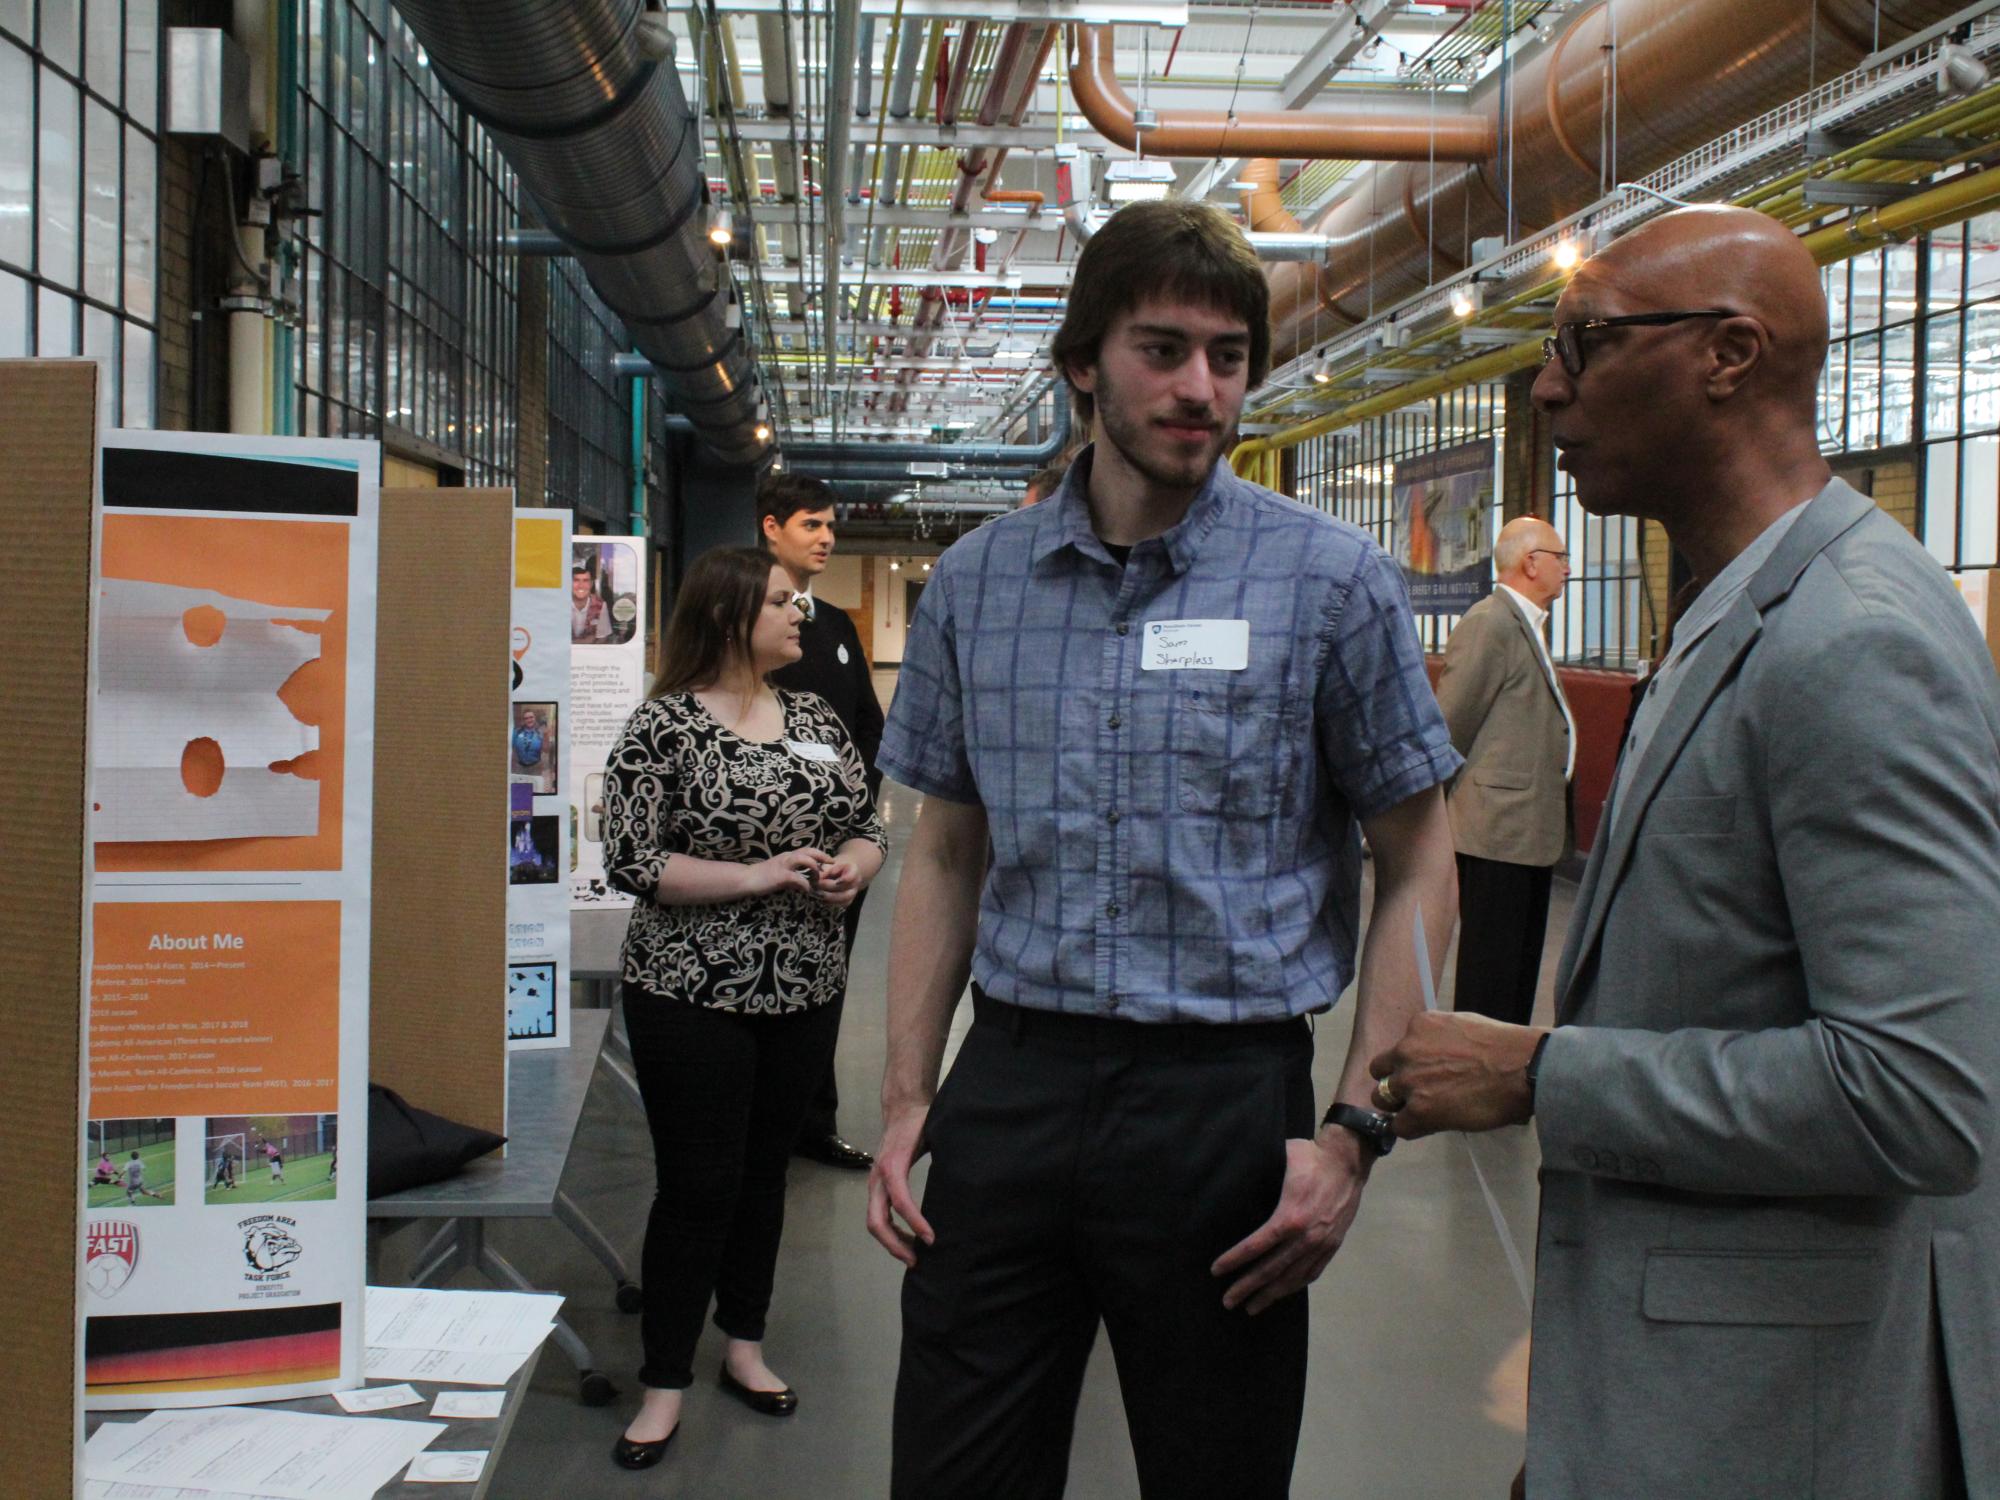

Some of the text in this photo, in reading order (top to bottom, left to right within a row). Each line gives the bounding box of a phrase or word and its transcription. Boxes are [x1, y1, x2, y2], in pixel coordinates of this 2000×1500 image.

[1158, 636, 1189, 649] Sam
[1156, 651, 1214, 667] Sharpless
[148, 932, 245, 951] About Me
[237, 1215, 297, 1229] FREEDOM AREA
[244, 1270, 291, 1281] TASK FORCE
